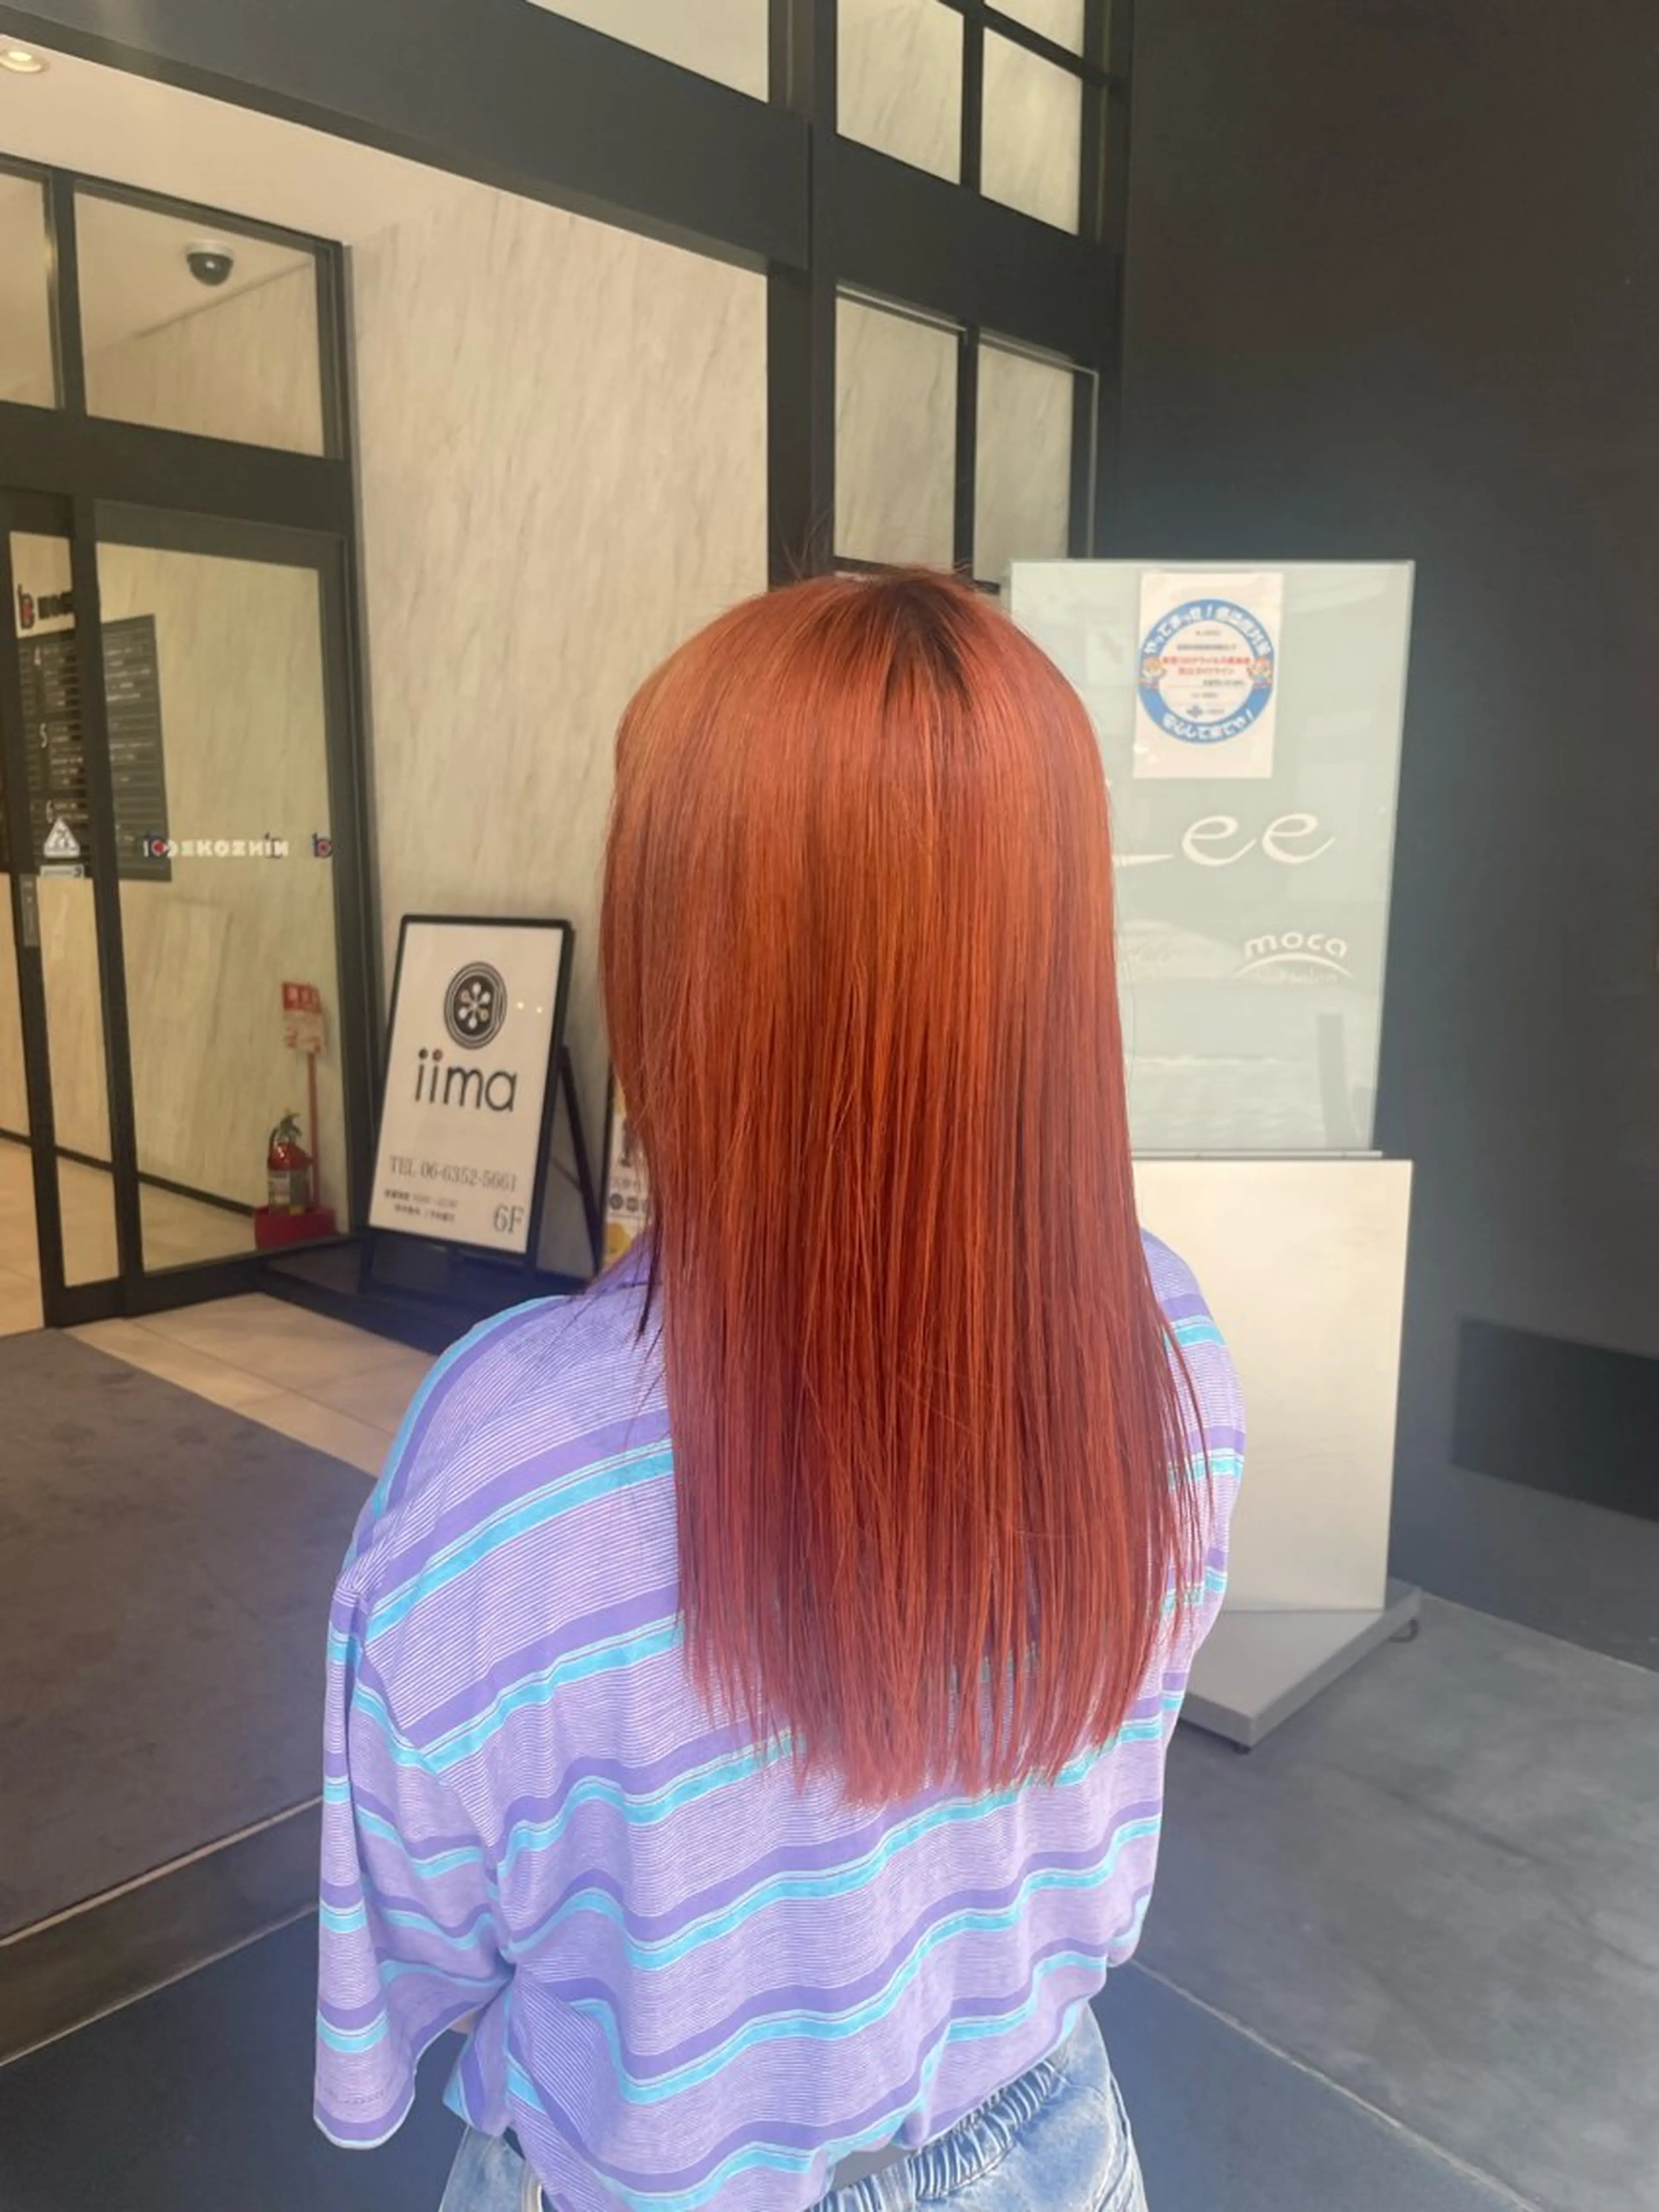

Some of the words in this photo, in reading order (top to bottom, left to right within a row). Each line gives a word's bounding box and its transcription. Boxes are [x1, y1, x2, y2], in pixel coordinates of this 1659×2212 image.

[1245, 931, 1347, 960] moca
[415, 1047, 517, 1112] iima
[389, 1155, 413, 1177] TEL
[494, 1203, 524, 1234] 6F
